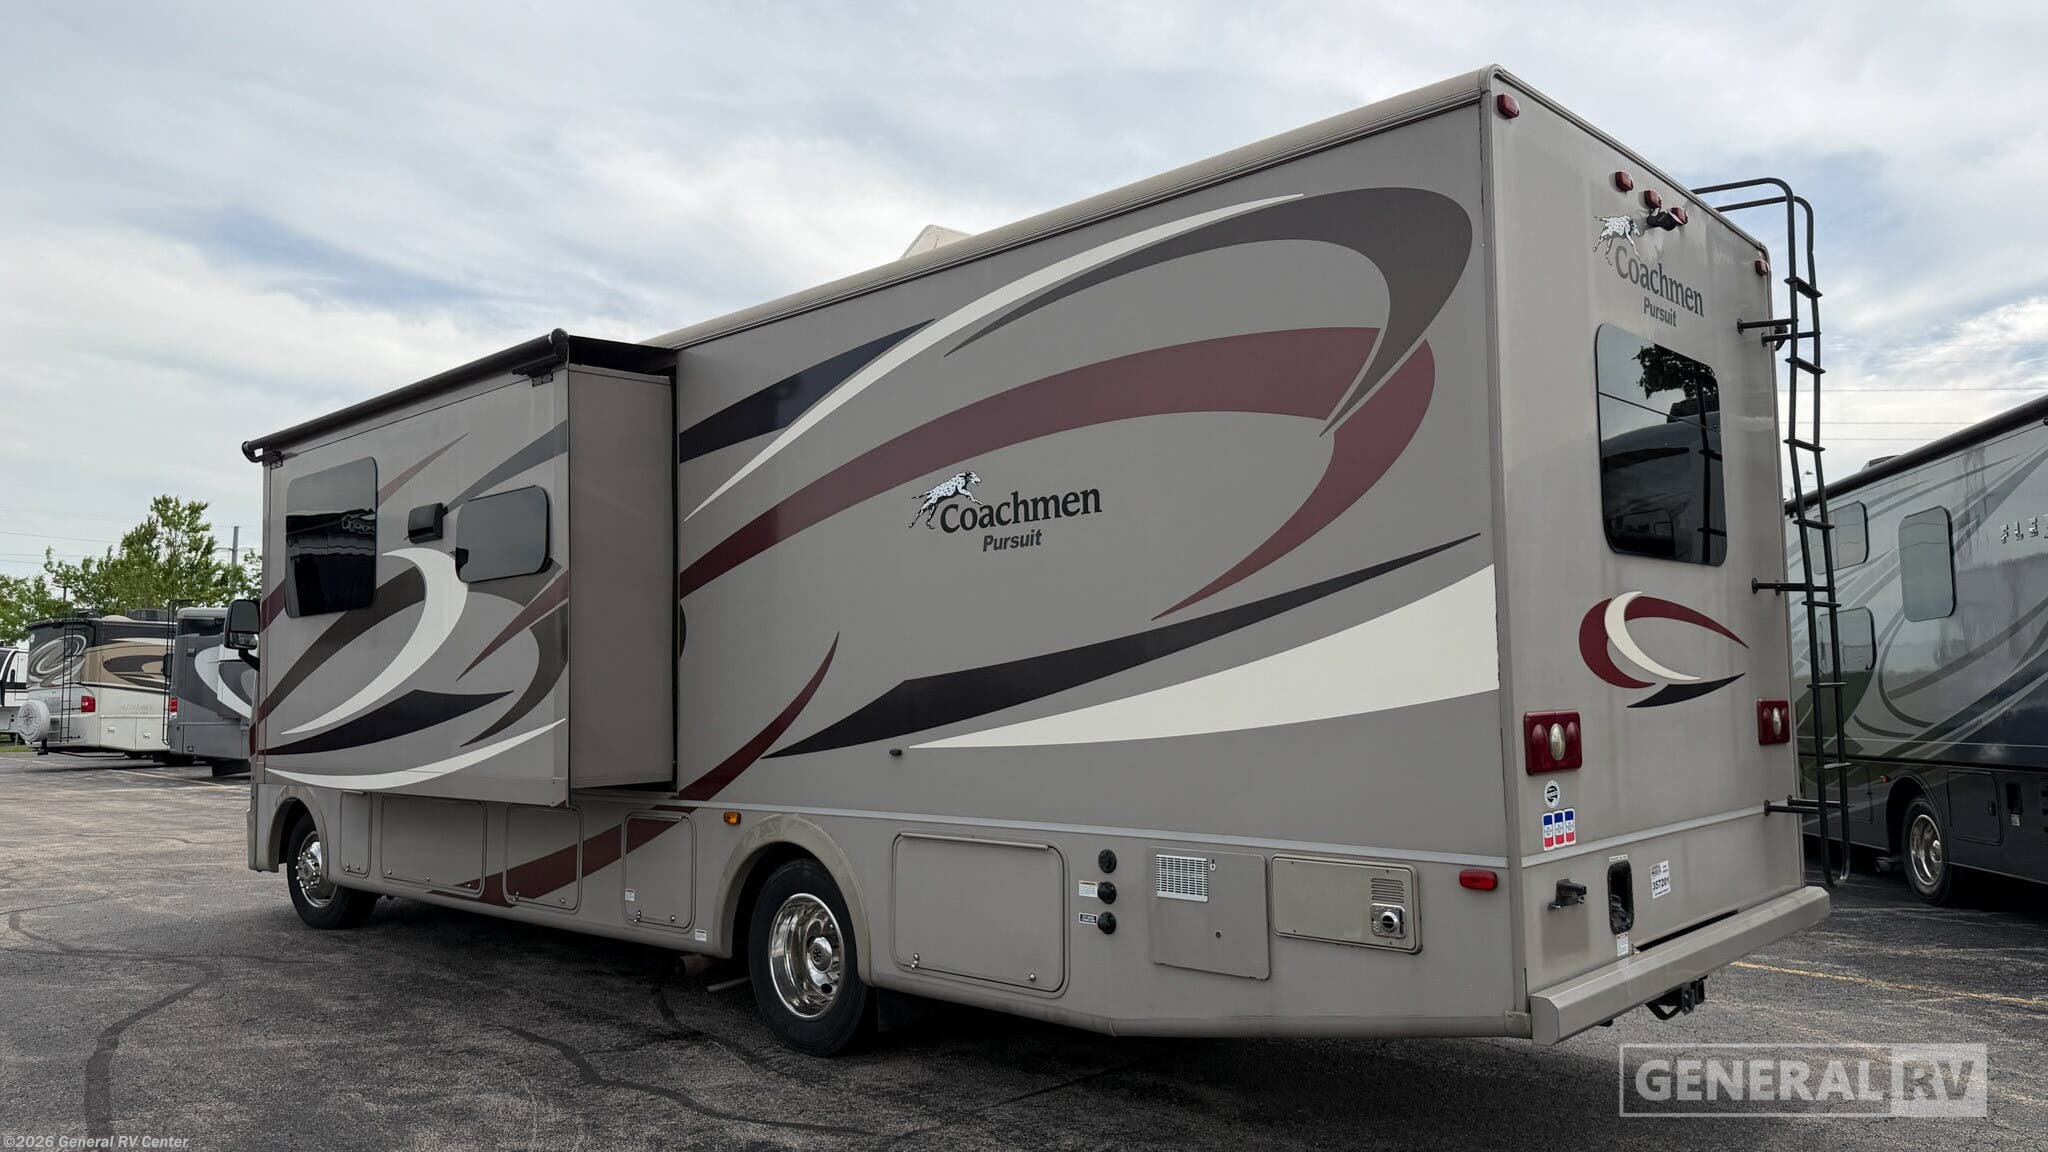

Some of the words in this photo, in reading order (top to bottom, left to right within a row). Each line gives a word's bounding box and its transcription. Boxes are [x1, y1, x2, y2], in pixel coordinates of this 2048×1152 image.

[1615, 246, 1704, 317] Coachmen
[1643, 296, 1677, 327] Pursuit
[940, 488, 1102, 534] Coachmen
[982, 529, 1042, 552] Pursuit
